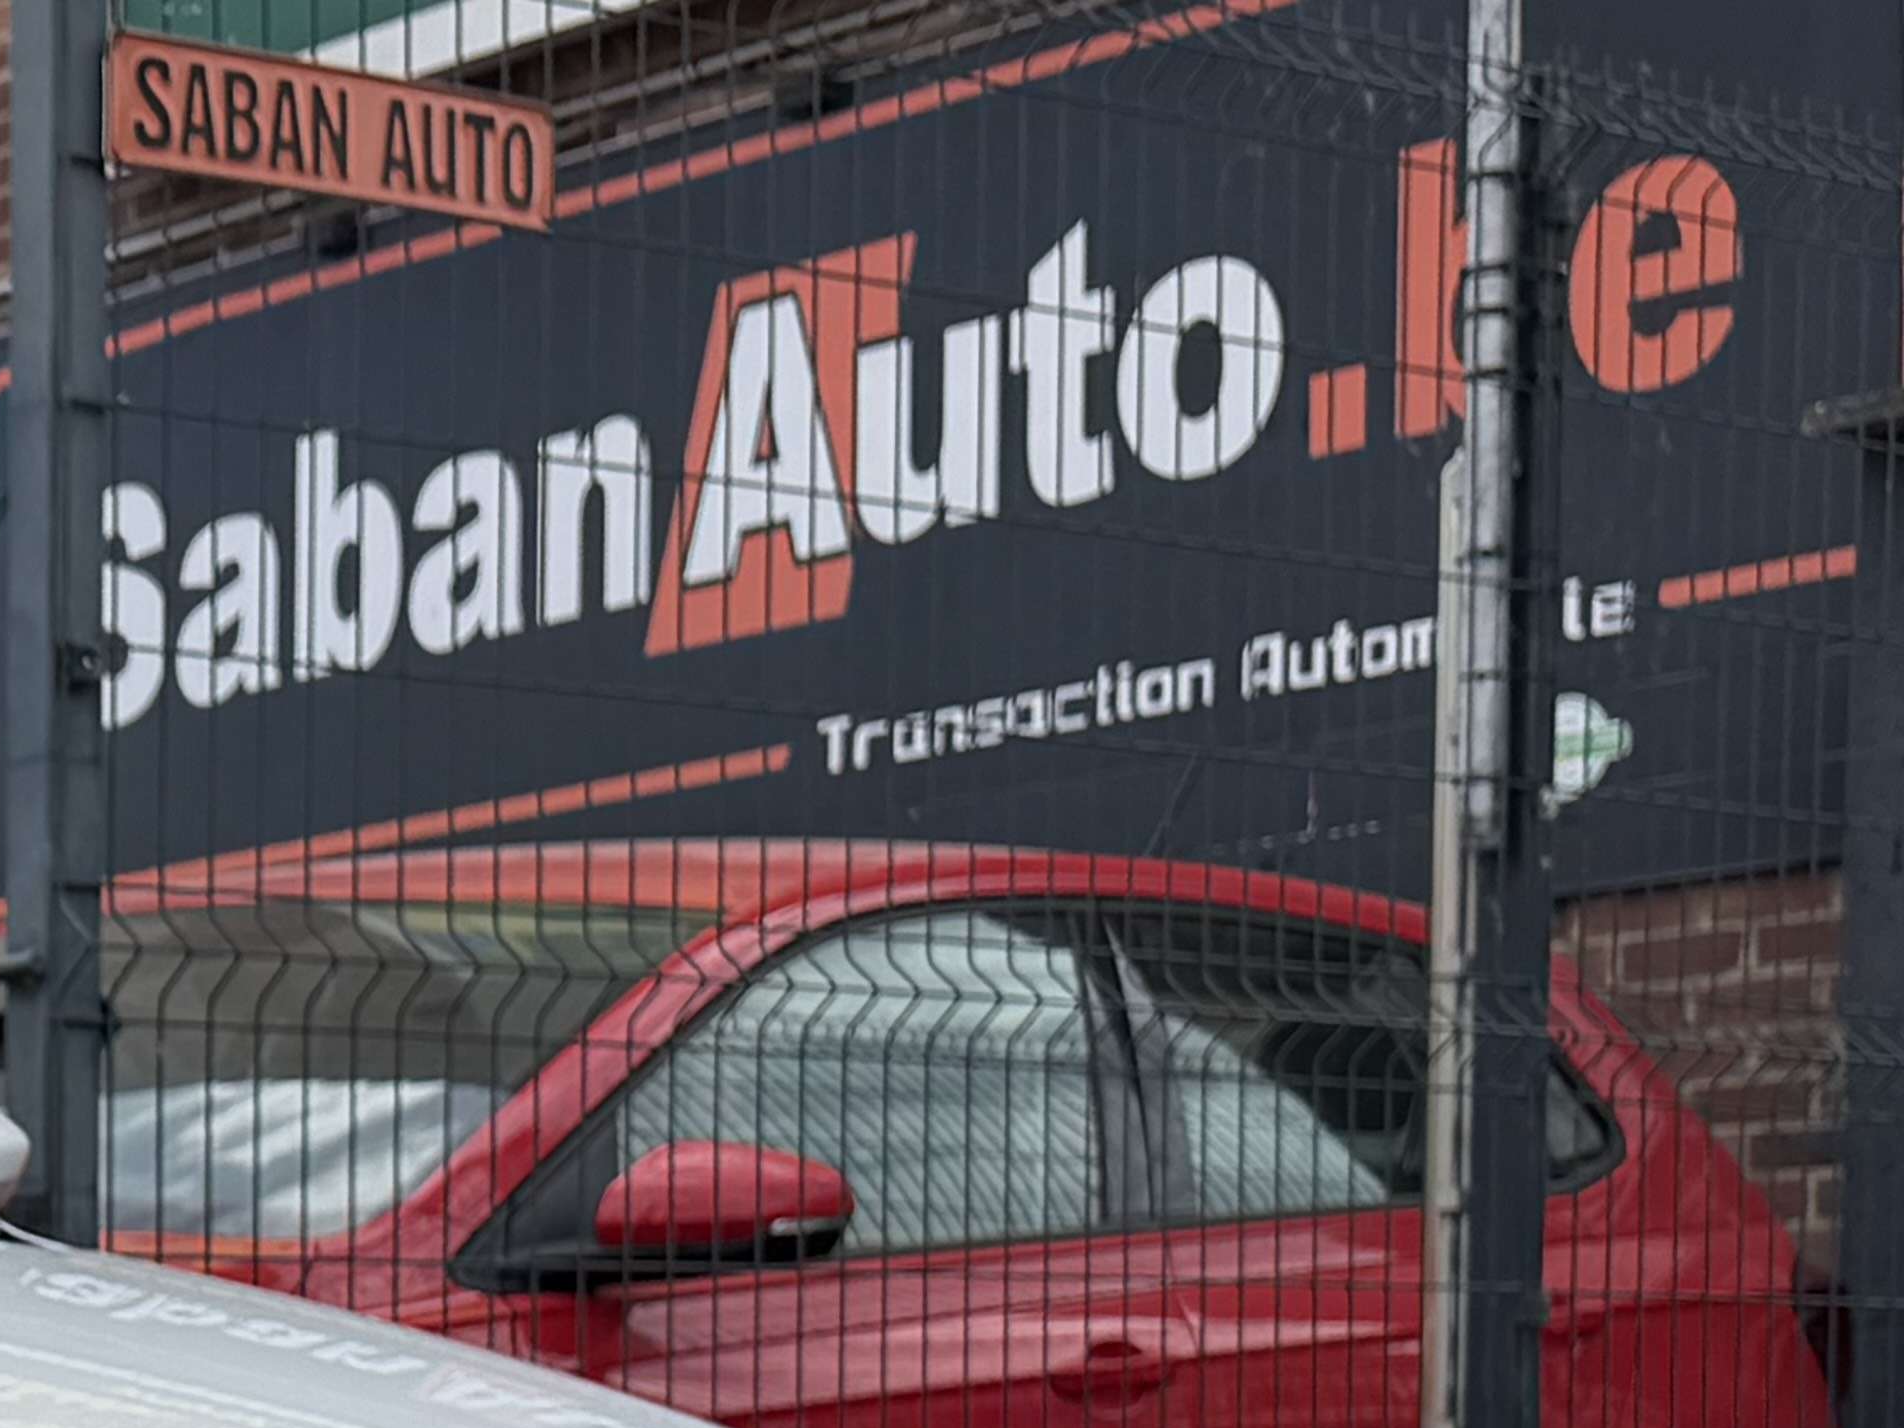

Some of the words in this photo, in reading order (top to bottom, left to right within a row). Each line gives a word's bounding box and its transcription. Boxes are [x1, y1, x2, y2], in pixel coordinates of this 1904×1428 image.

[130, 55, 350, 182] SABAN
[380, 98, 537, 212] AUTO
[817, 656, 1215, 776] Transaction
[1242, 574, 1636, 701] Automle
